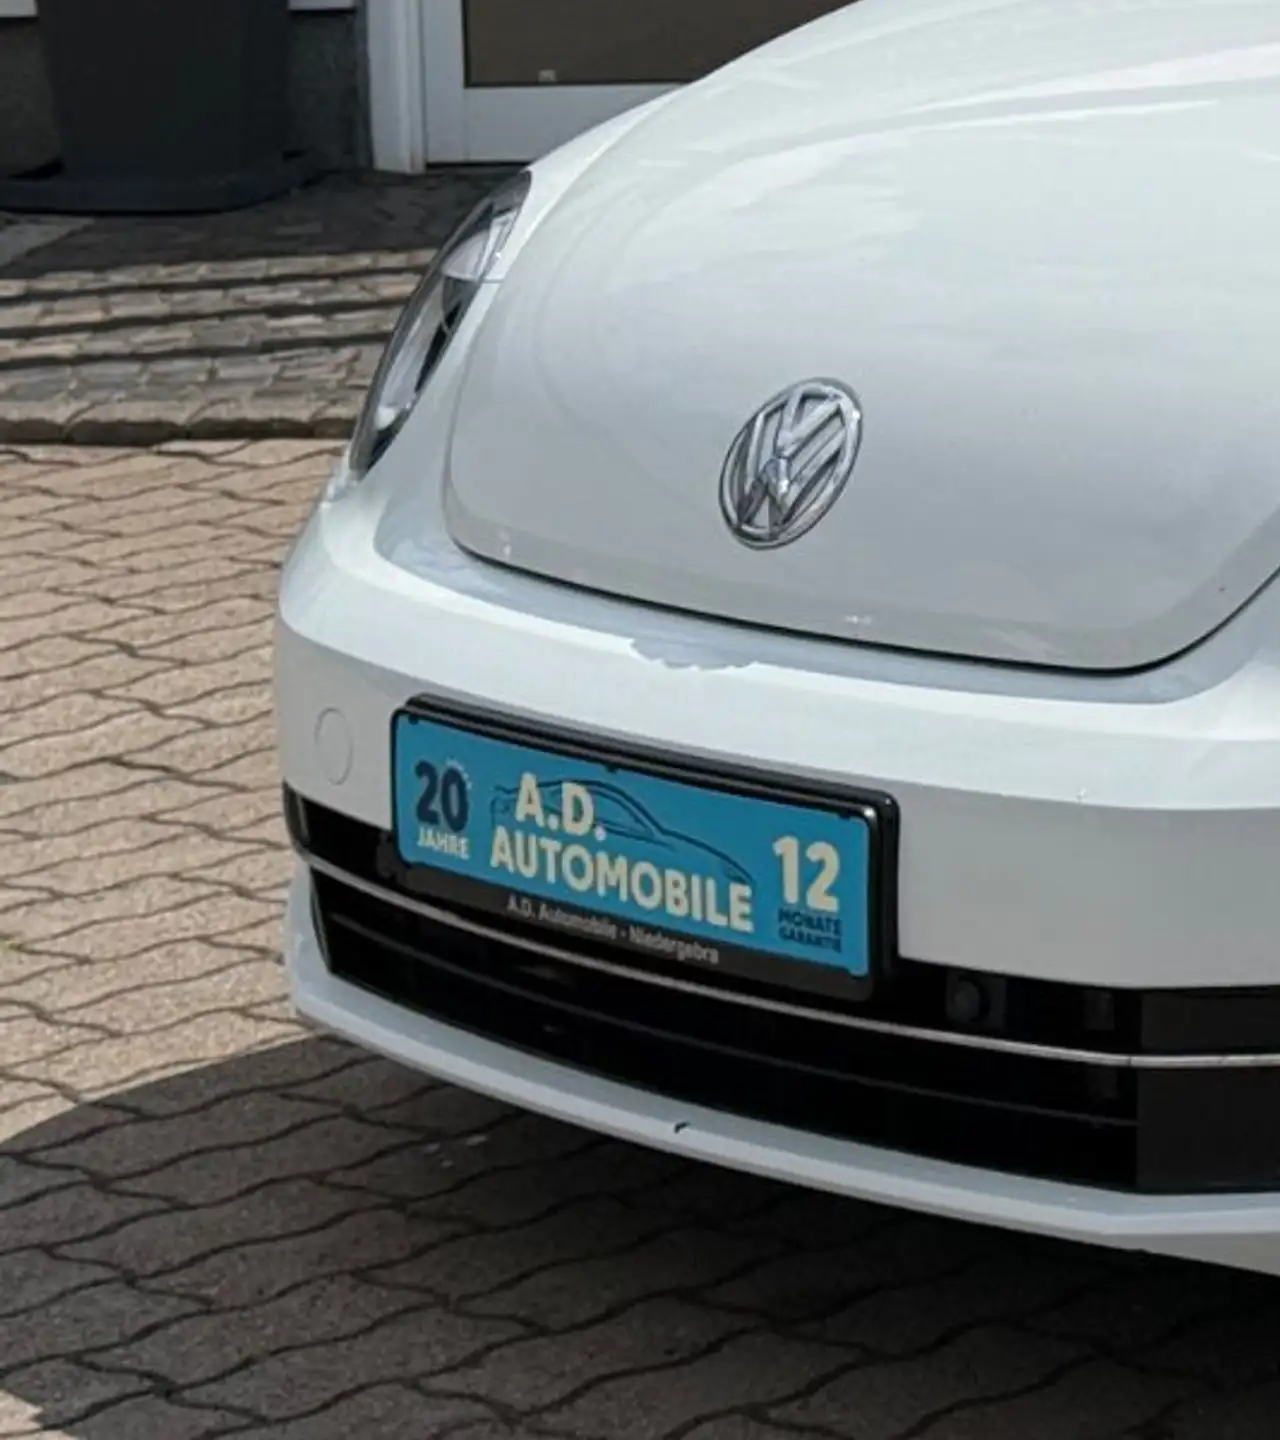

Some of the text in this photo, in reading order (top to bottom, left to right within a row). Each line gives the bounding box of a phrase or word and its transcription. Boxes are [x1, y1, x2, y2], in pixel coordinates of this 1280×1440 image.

[415, 760, 470, 833] 20
[514, 771, 607, 842] A.D.
[417, 827, 470, 860] JAHRE
[490, 826, 755, 933] AUTOMOBILE
[773, 835, 841, 914] 12
